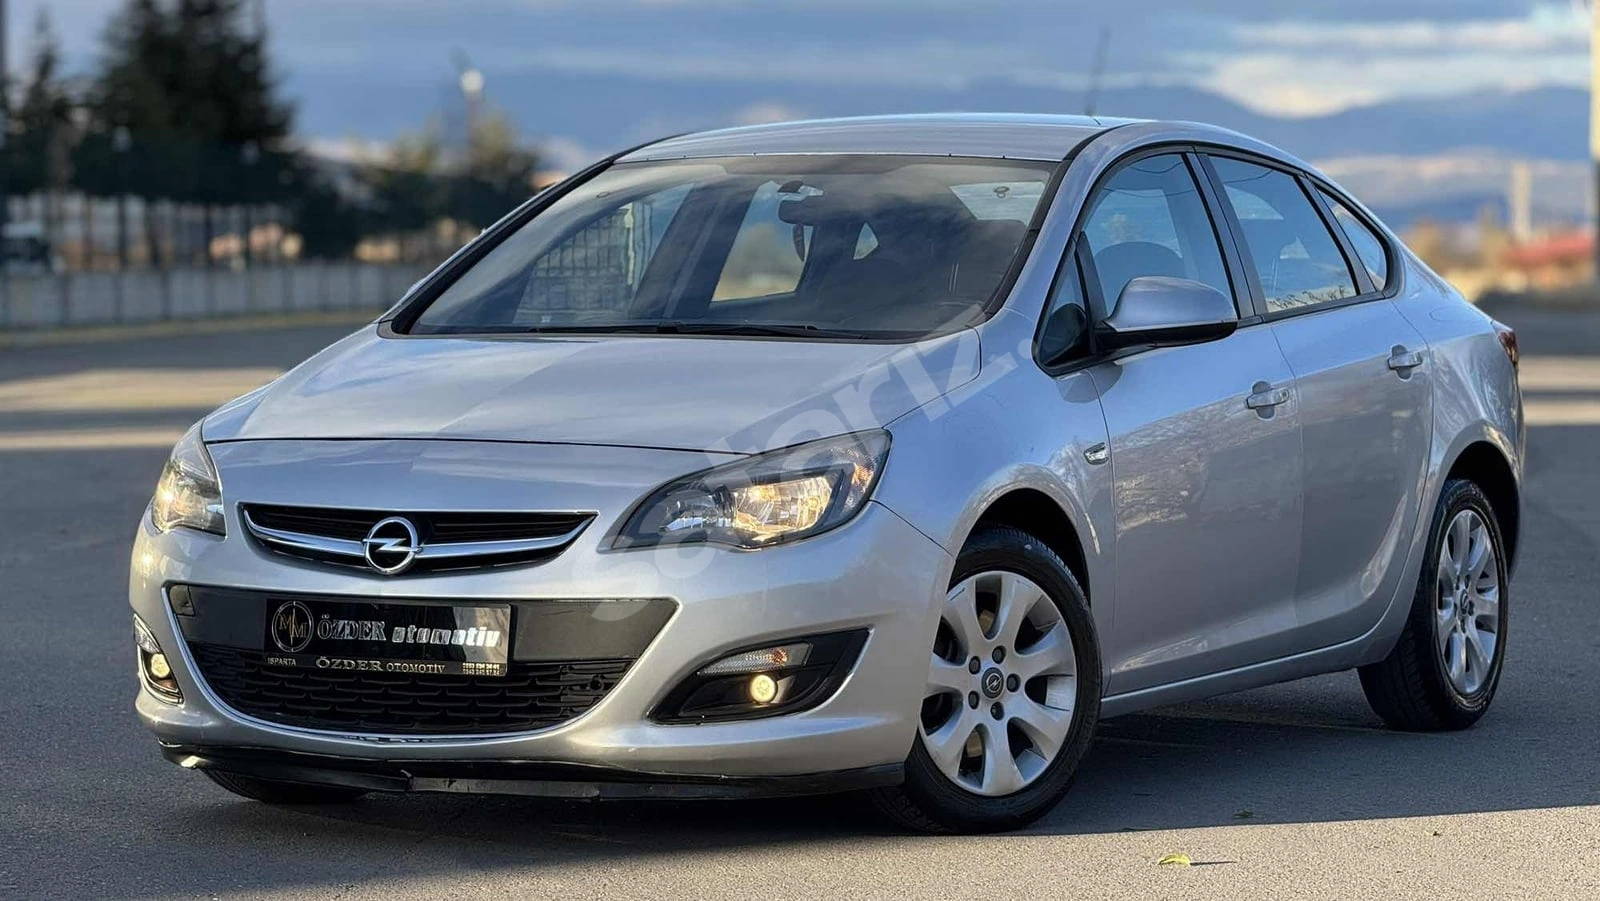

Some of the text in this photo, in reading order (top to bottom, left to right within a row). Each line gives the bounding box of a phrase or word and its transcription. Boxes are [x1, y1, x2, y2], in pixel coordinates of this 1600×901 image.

[317, 613, 387, 641] ÖZDER
[315, 656, 384, 672] ÖZDER
[386, 662, 446, 674] OTOMOTİV
